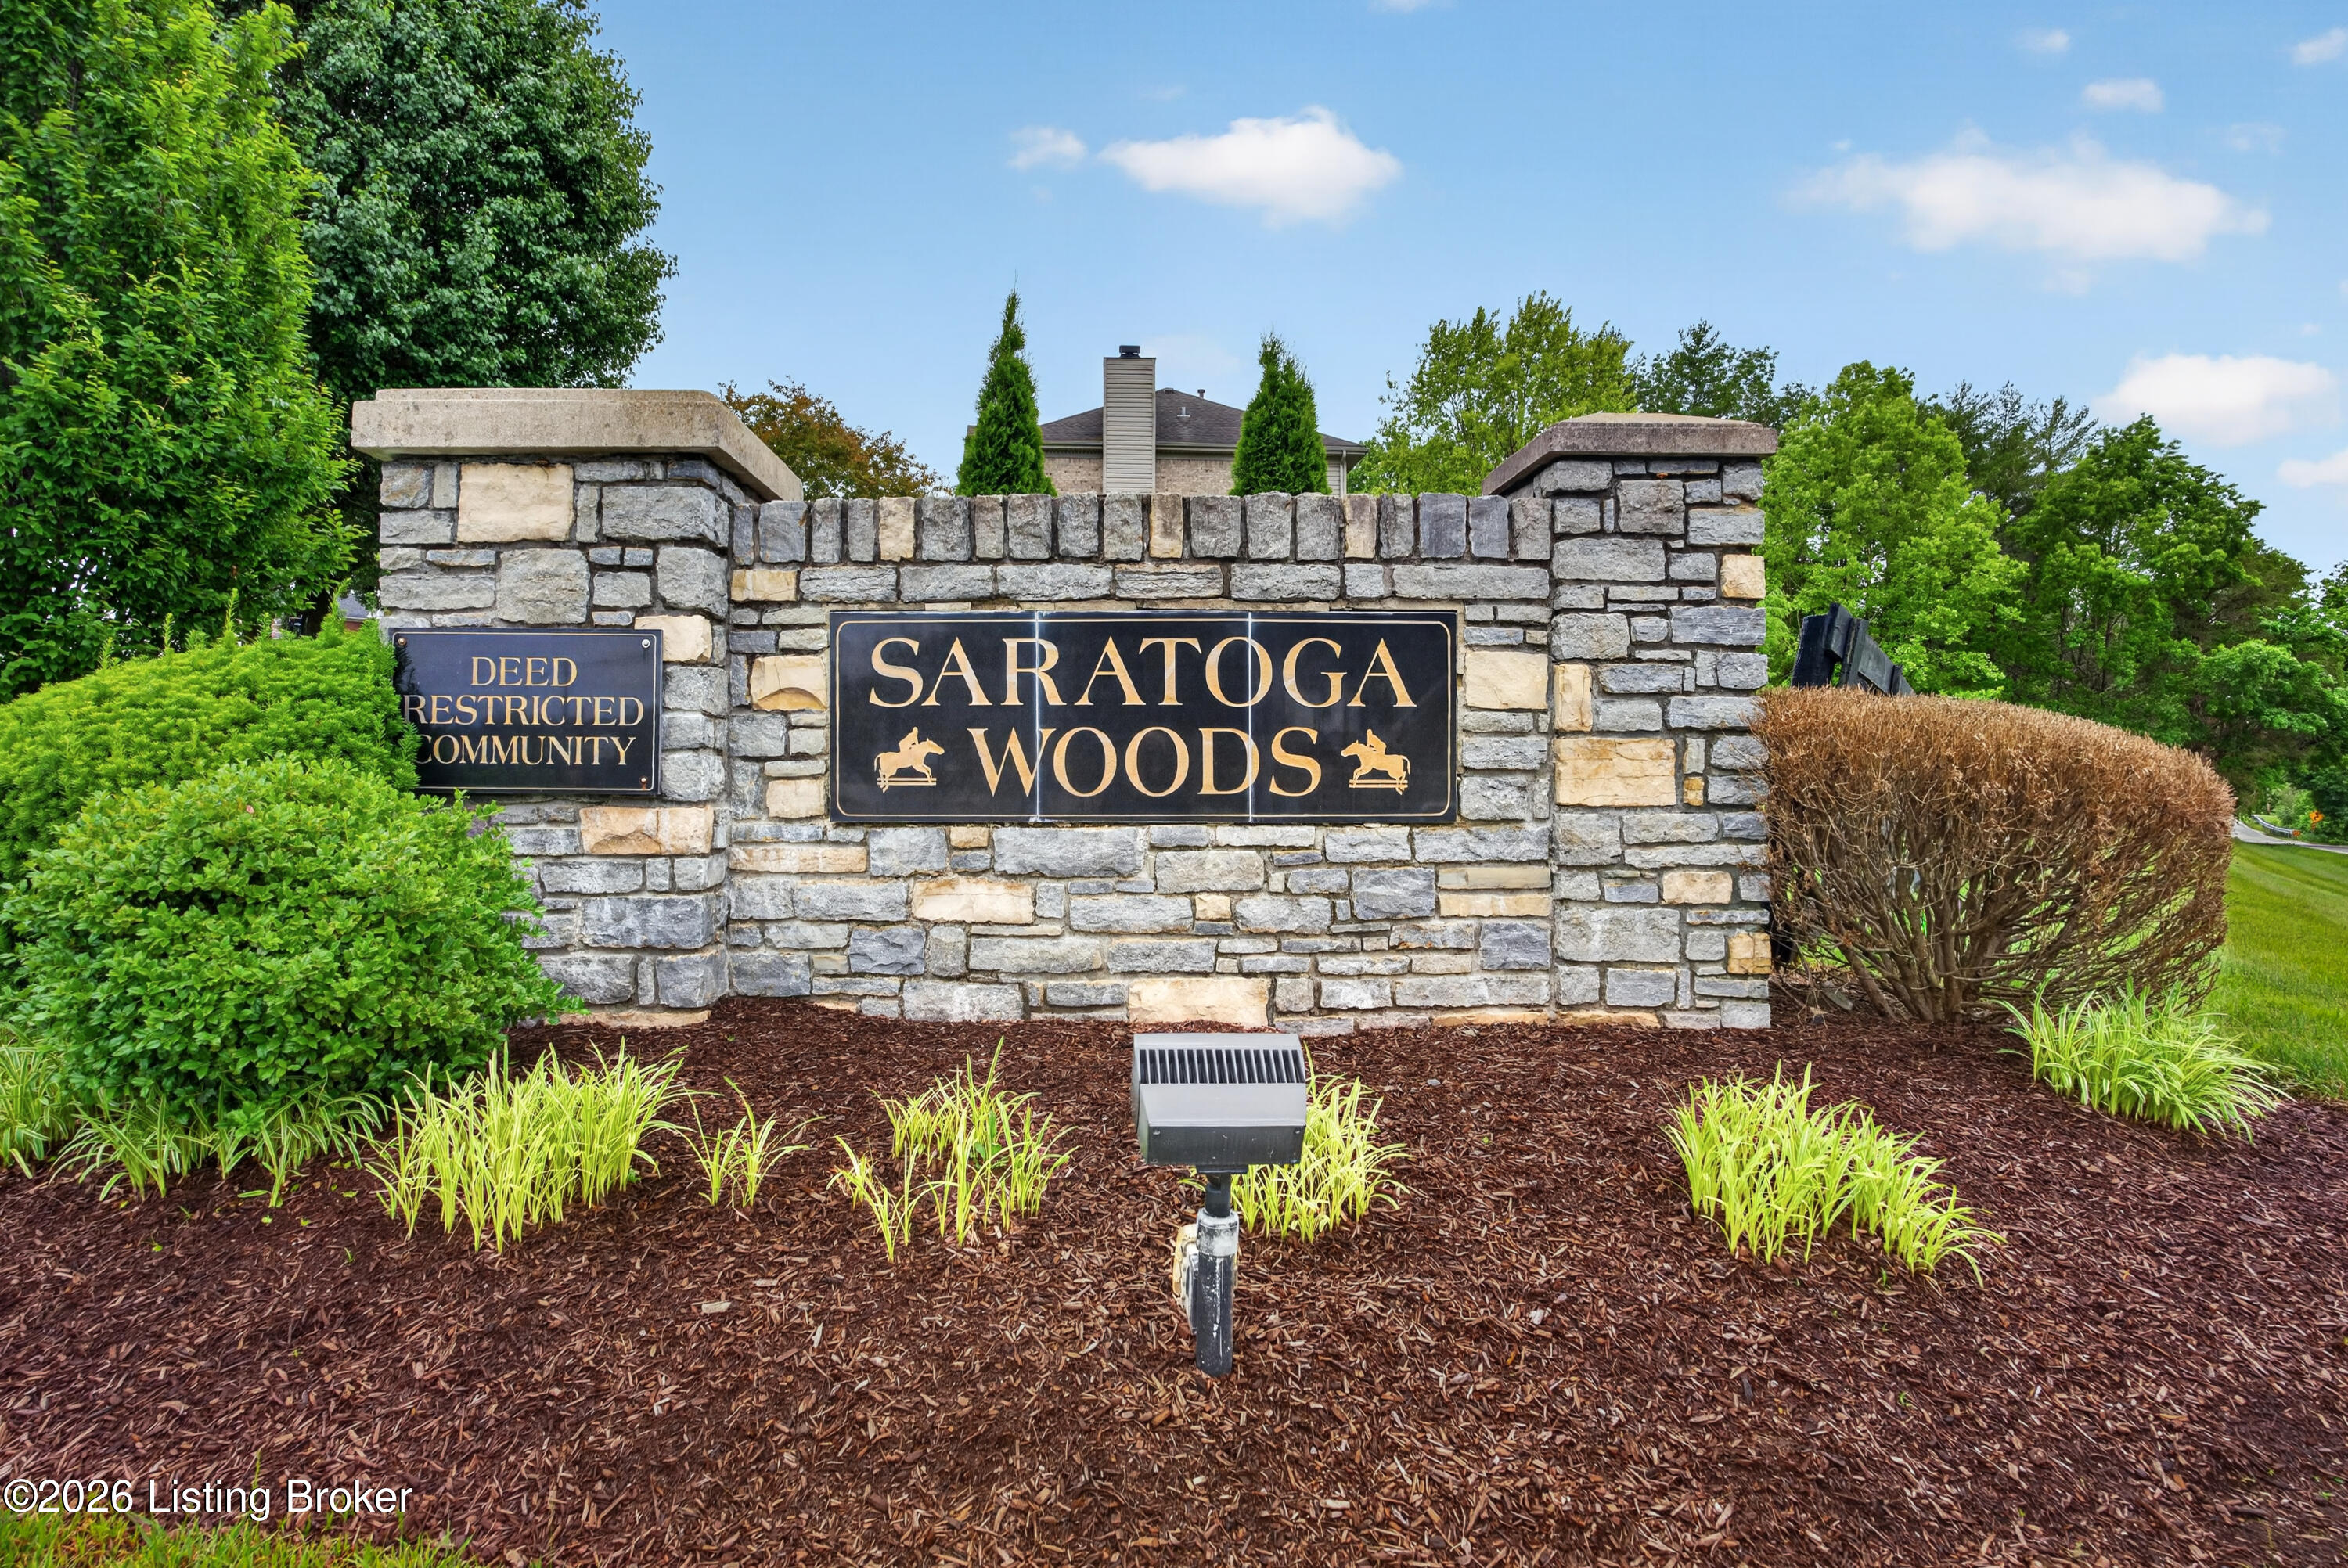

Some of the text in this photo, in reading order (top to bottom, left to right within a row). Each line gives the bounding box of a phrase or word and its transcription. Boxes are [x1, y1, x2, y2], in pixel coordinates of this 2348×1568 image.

[471, 656, 578, 687] DEED
[869, 635, 1417, 708] SARATOGA
[404, 695, 644, 726] RESTRICTED
[967, 726, 1323, 797] WOODS
